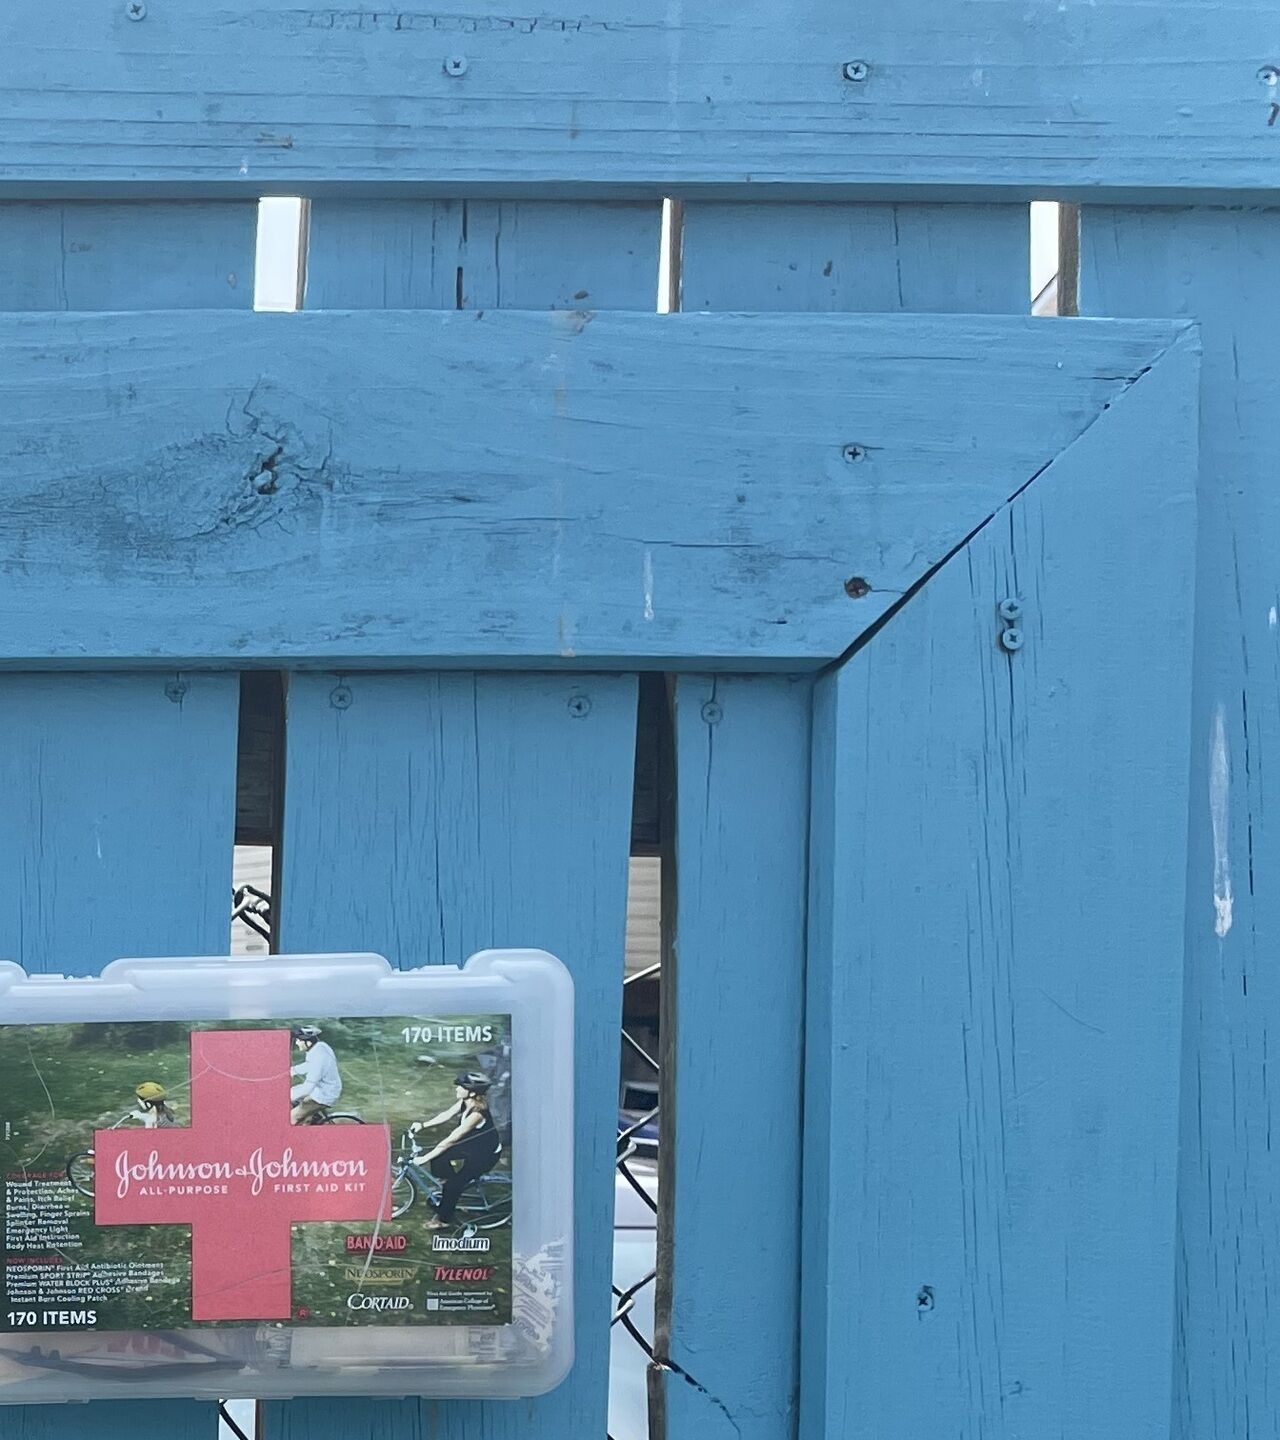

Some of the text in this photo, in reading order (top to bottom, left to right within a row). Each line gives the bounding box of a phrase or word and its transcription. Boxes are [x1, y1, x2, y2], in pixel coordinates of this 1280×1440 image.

[401, 1025, 492, 1043] 170 ITEMS
[274, 1183, 310, 1194] FIRST
[316, 1183, 338, 1193] AID
[344, 1182, 366, 1193] KIT
[432, 1234, 491, 1252] Imodium
[6, 1310, 98, 1326] 170 ITEMS
